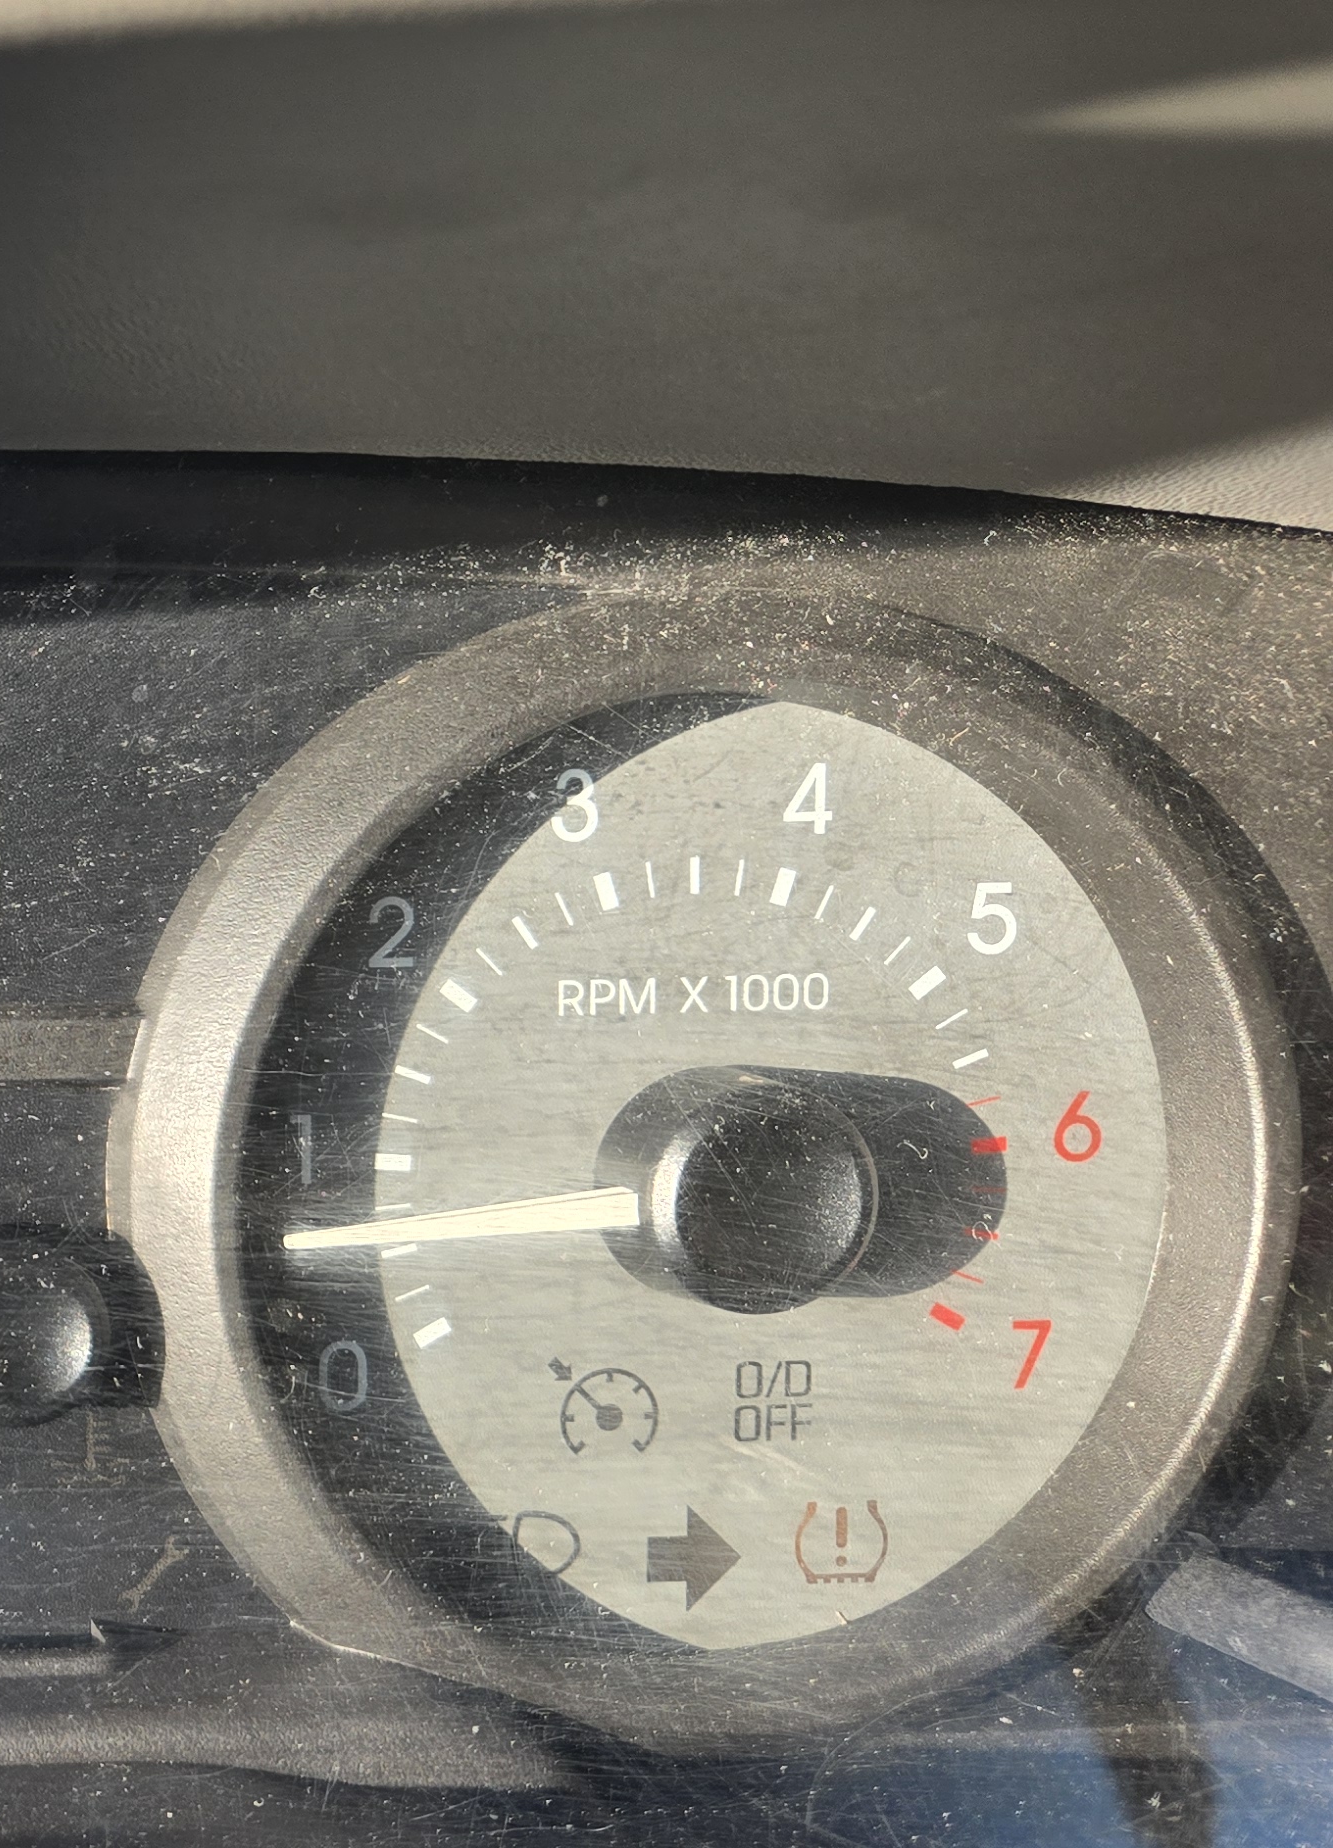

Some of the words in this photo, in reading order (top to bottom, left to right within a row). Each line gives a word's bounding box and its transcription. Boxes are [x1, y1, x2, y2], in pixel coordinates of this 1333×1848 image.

[551, 768, 599, 843] 3
[783, 762, 833, 836] 4
[366, 896, 417, 970] 2
[966, 881, 1019, 956] 5
[556, 977, 657, 1017] RPM
[679, 976, 710, 1014] X
[725, 971, 831, 1012] 1000
[289, 1113, 313, 1184] 1
[1053, 1089, 1103, 1163] 6
[318, 1339, 369, 1412] 0
[735, 1359, 813, 1399] O/D
[1012, 1318, 1053, 1390] 7
[733, 1403, 814, 1443] OFF
